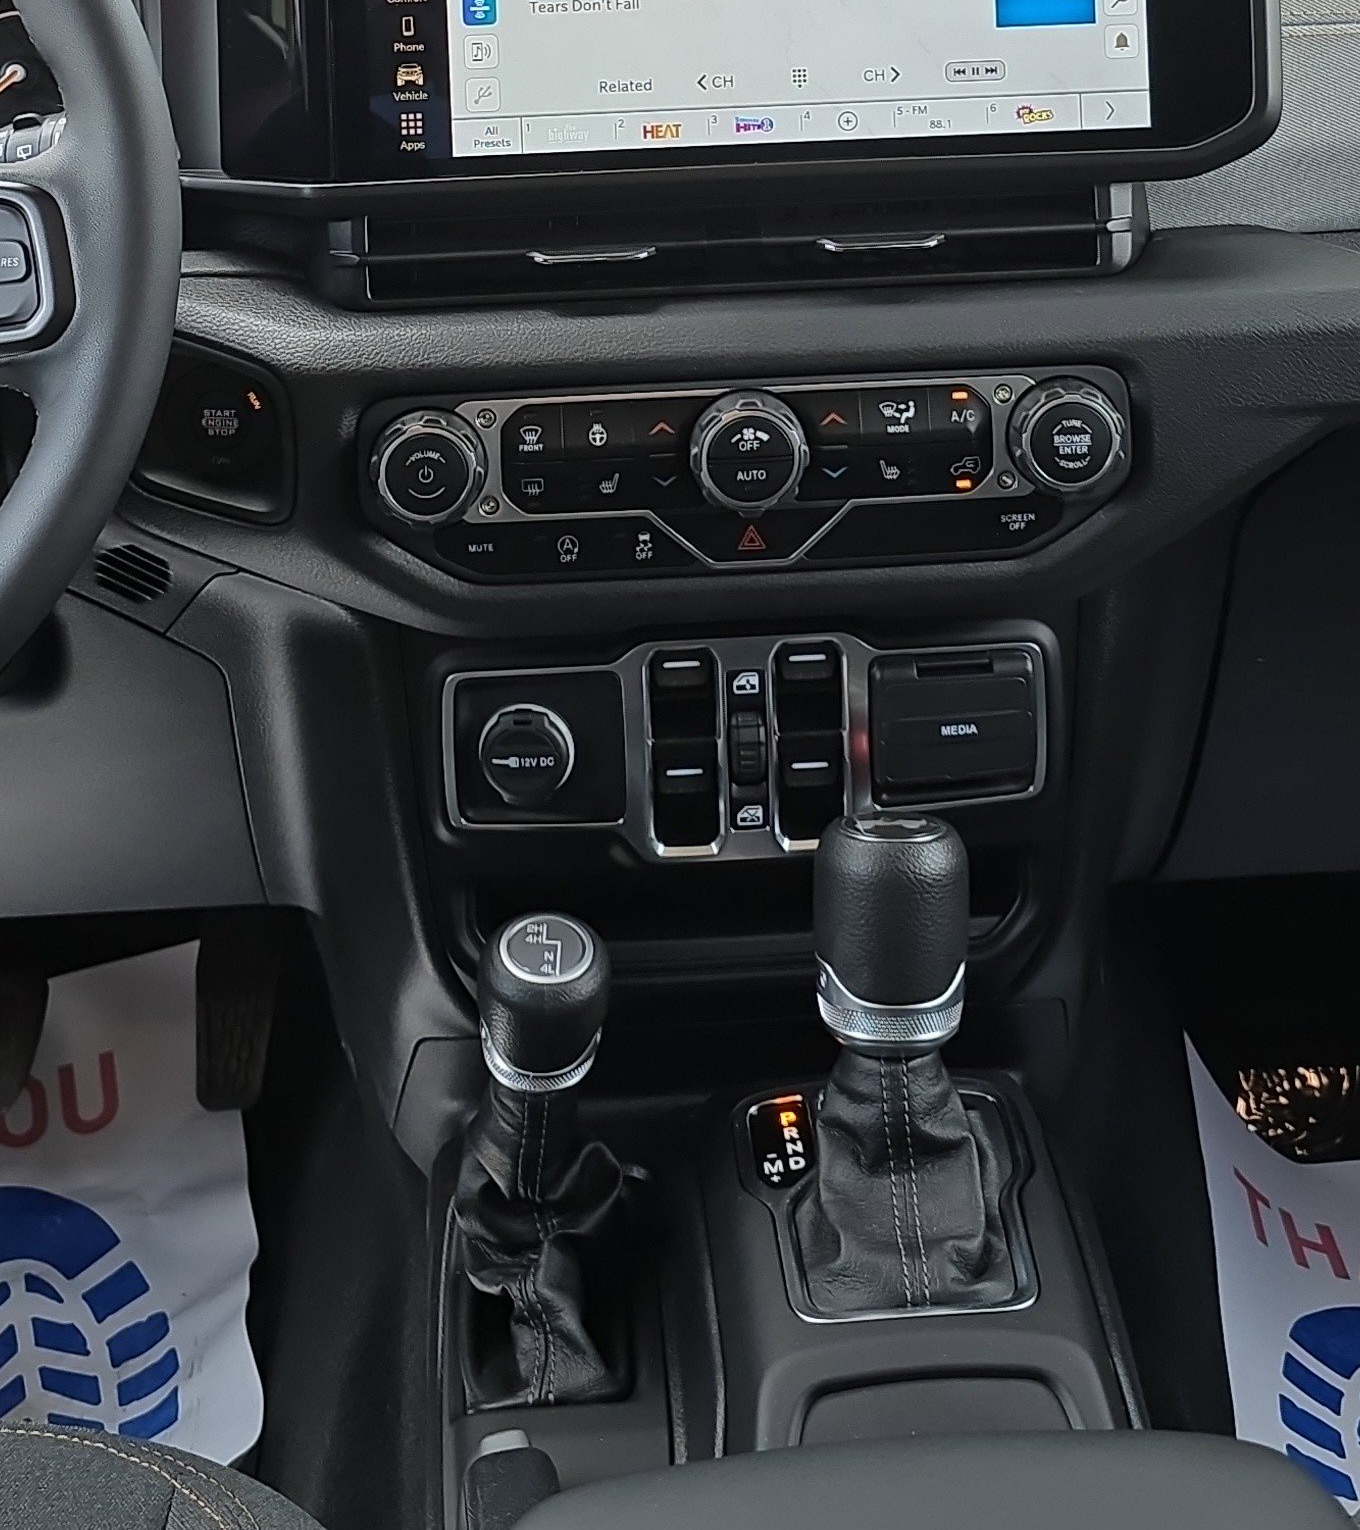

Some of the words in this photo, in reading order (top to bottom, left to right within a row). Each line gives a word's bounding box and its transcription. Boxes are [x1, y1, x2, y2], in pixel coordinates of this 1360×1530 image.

[529, 1, 568, 14] Tears
[393, 43, 425, 52] Phone
[863, 69, 885, 82] CH
[599, 79, 653, 93] Related
[712, 75, 734, 88] CH
[393, 91, 429, 101] Vehicle
[897, 106, 903, 115] 5
[912, 105, 928, 115] FM
[990, 103, 997, 112] 6
[711, 115, 718, 124] 3
[803, 111, 810, 120] 4
[618, 119, 625, 129] 2
[929, 119, 952, 129] 88.1
[485, 127, 498, 136] All
[642, 122, 682, 140] HEAT
[400, 141, 426, 151] Apps
[474, 139, 511, 149] Presets
[0, 257, 19, 267] RES
[950, 408, 976, 423] A/C
[202, 418, 239, 427] ENGINE
[1061, 419, 1082, 428] TUNE
[886, 423, 911, 435] MODE
[1053, 434, 1091, 443] BROWSE
[519, 444, 543, 452] FRONT
[738, 439, 760, 452] OFF
[1059, 446, 1088, 455] ENTER
[410, 450, 441, 462] VOLUME
[1059, 459, 1088, 469] SCROLL
[736, 468, 767, 482] AUTO
[1001, 513, 1035, 522] SCREEN
[1009, 522, 1026, 530] OFF
[468, 543, 494, 552] MUTE
[559, 552, 578, 563] OFF
[635, 550, 654, 560] OFF
[940, 724, 978, 736] MEDIA
[520, 755, 538, 768] 12V
[540, 755, 555, 768] DC
[544, 951, 554, 961] N
[540, 964, 555, 974] 4L
[780, 1111, 796, 1126] P
[783, 1127, 800, 1140] R
[786, 1140, 804, 1155] N
[763, 1159, 784, 1174] M
[789, 1156, 806, 1170] D
